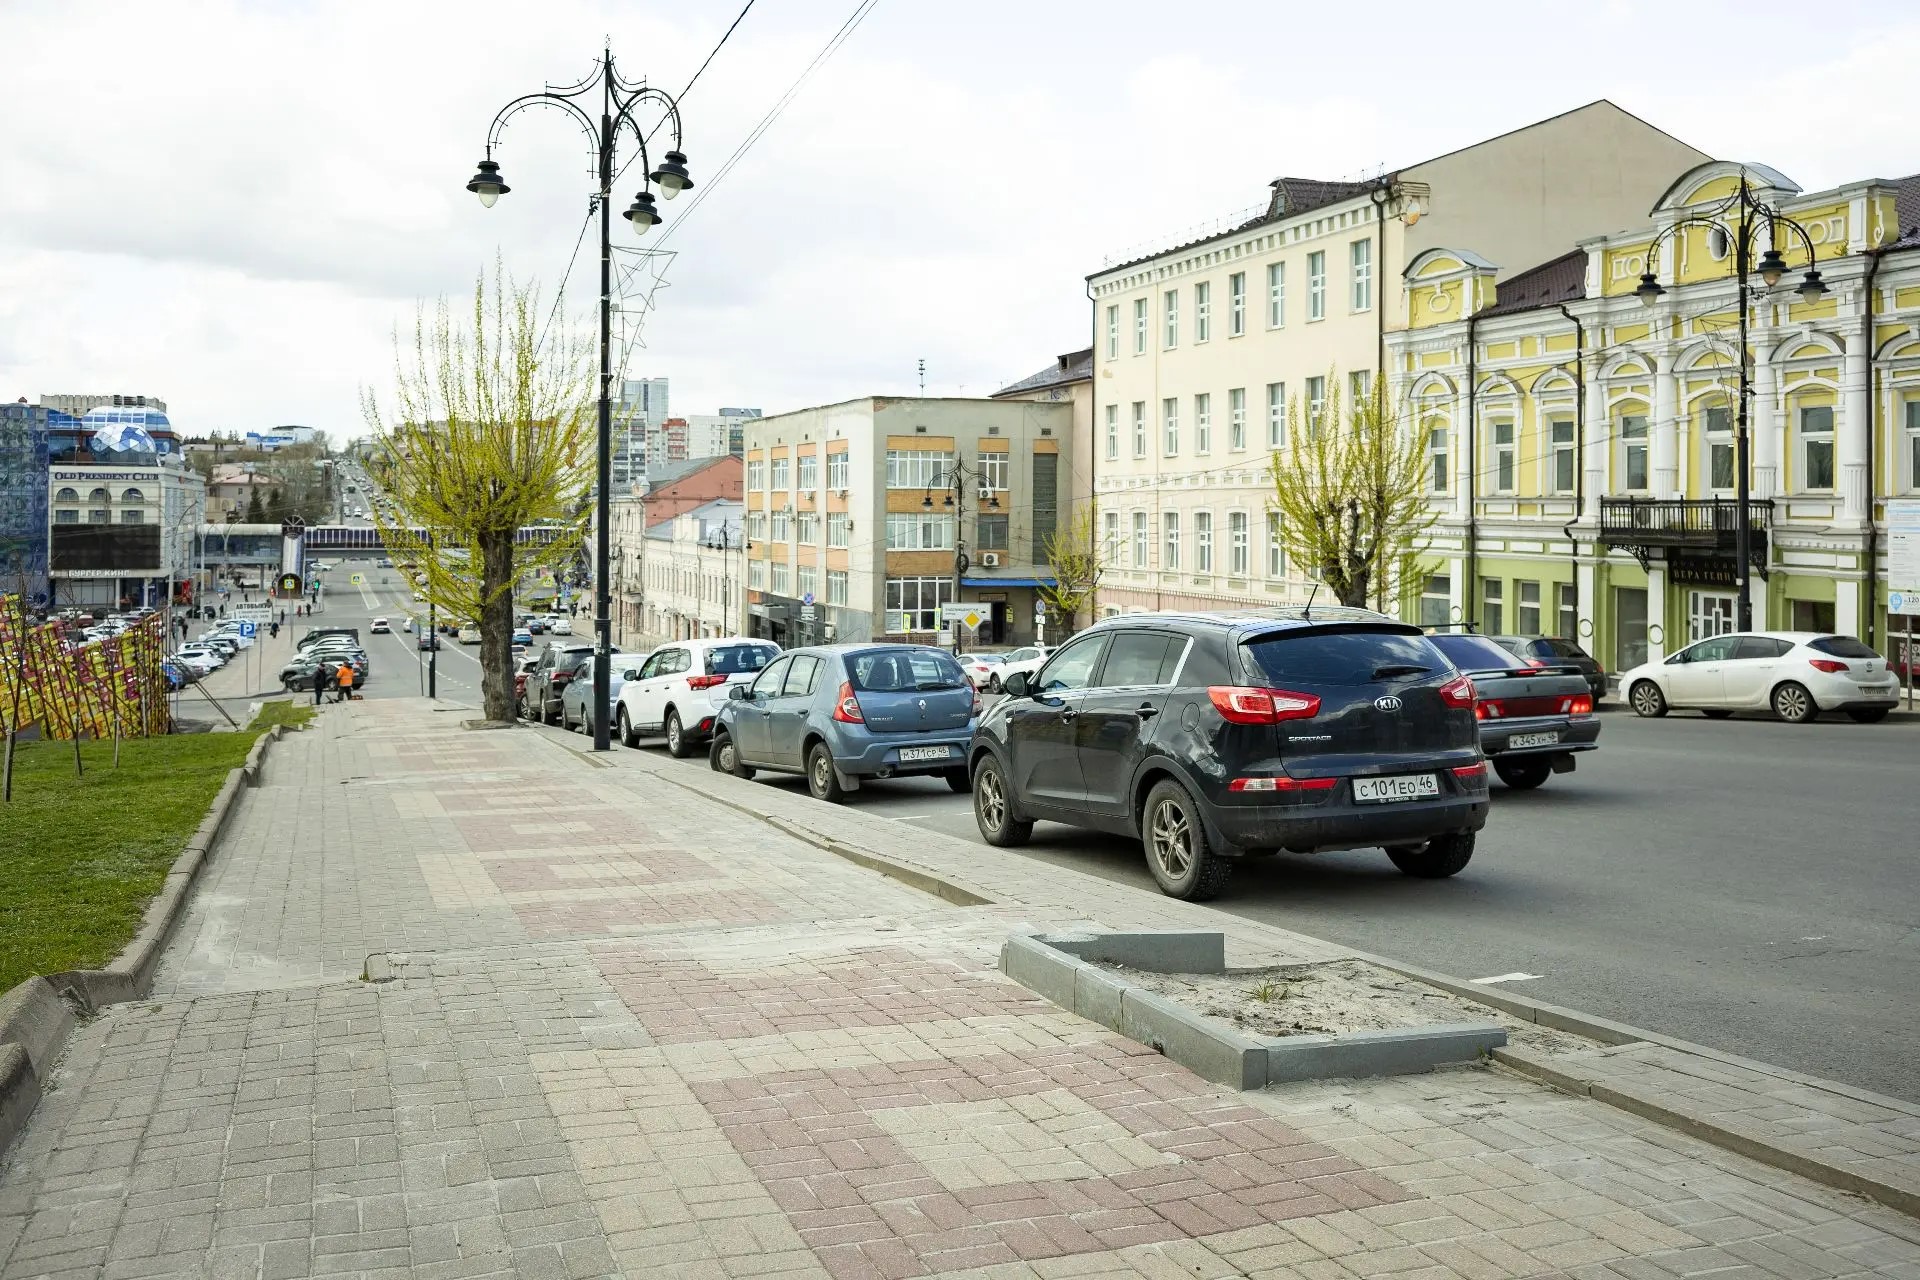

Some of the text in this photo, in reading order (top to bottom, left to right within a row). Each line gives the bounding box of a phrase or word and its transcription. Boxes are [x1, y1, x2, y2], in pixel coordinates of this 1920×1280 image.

[55, 472, 76, 480] OLD
[78, 472, 129, 480] PRESIDENT
[68, 569, 130, 577] БУРГЕР КИНГ
[1380, 699, 1399, 709] KIA
[1360, 776, 1432, 797] С101ЕО 46
